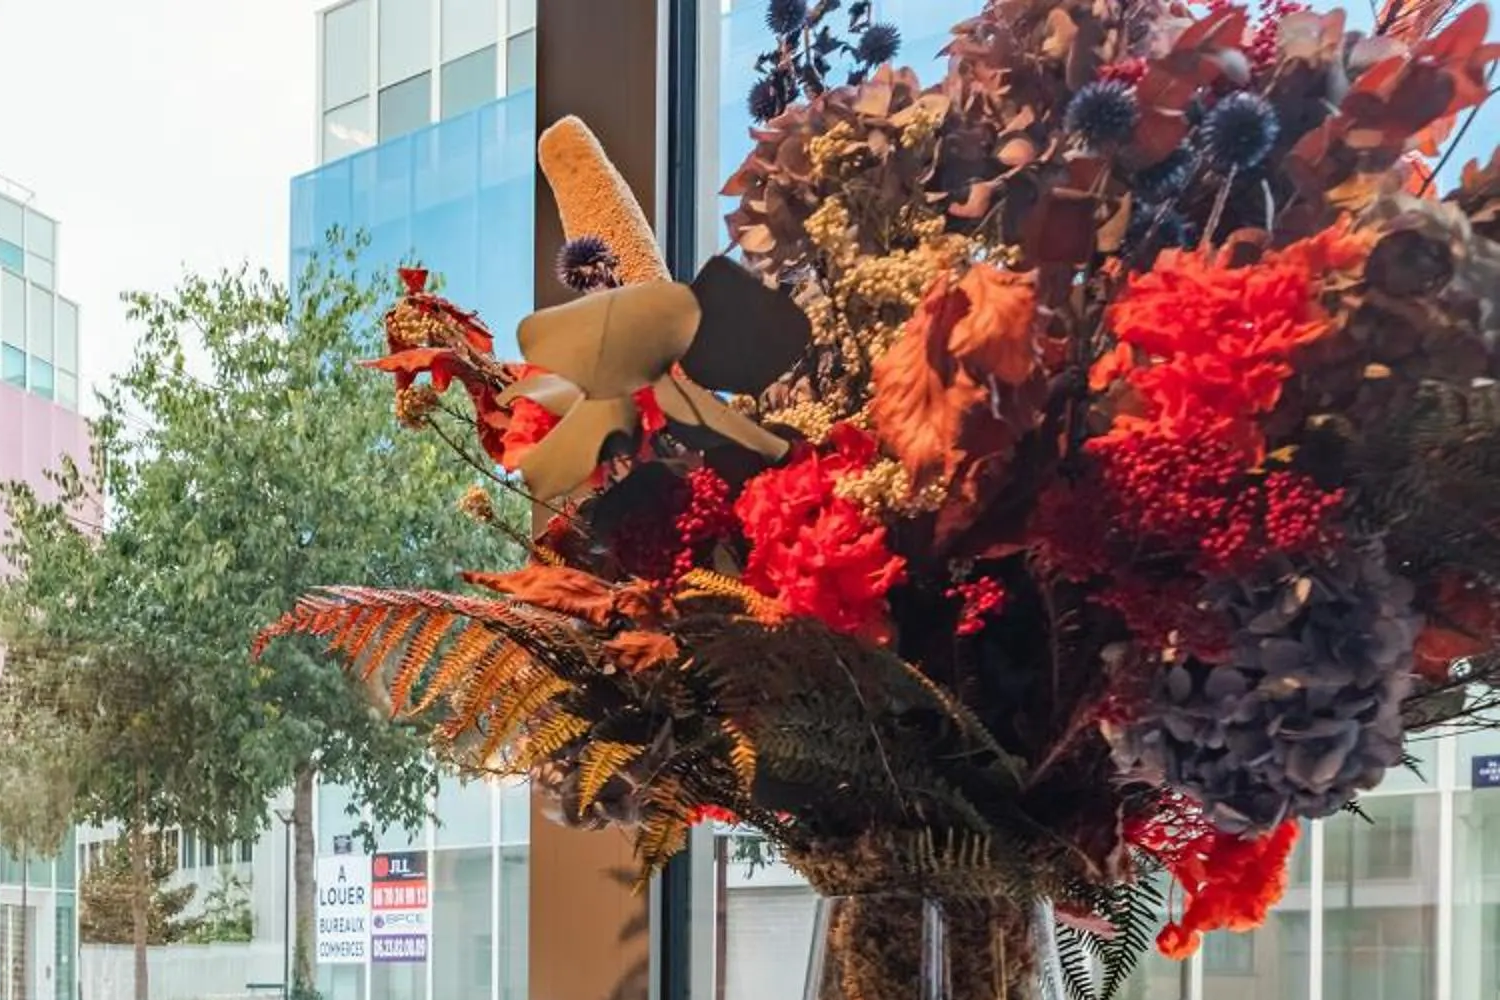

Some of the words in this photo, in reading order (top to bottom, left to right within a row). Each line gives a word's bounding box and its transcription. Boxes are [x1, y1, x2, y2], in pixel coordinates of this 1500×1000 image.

[388, 858, 410, 873] JLL
[319, 886, 365, 906] LOUER
[319, 917, 365, 933] BUREAUX
[319, 941, 365, 957] COMMERCES
